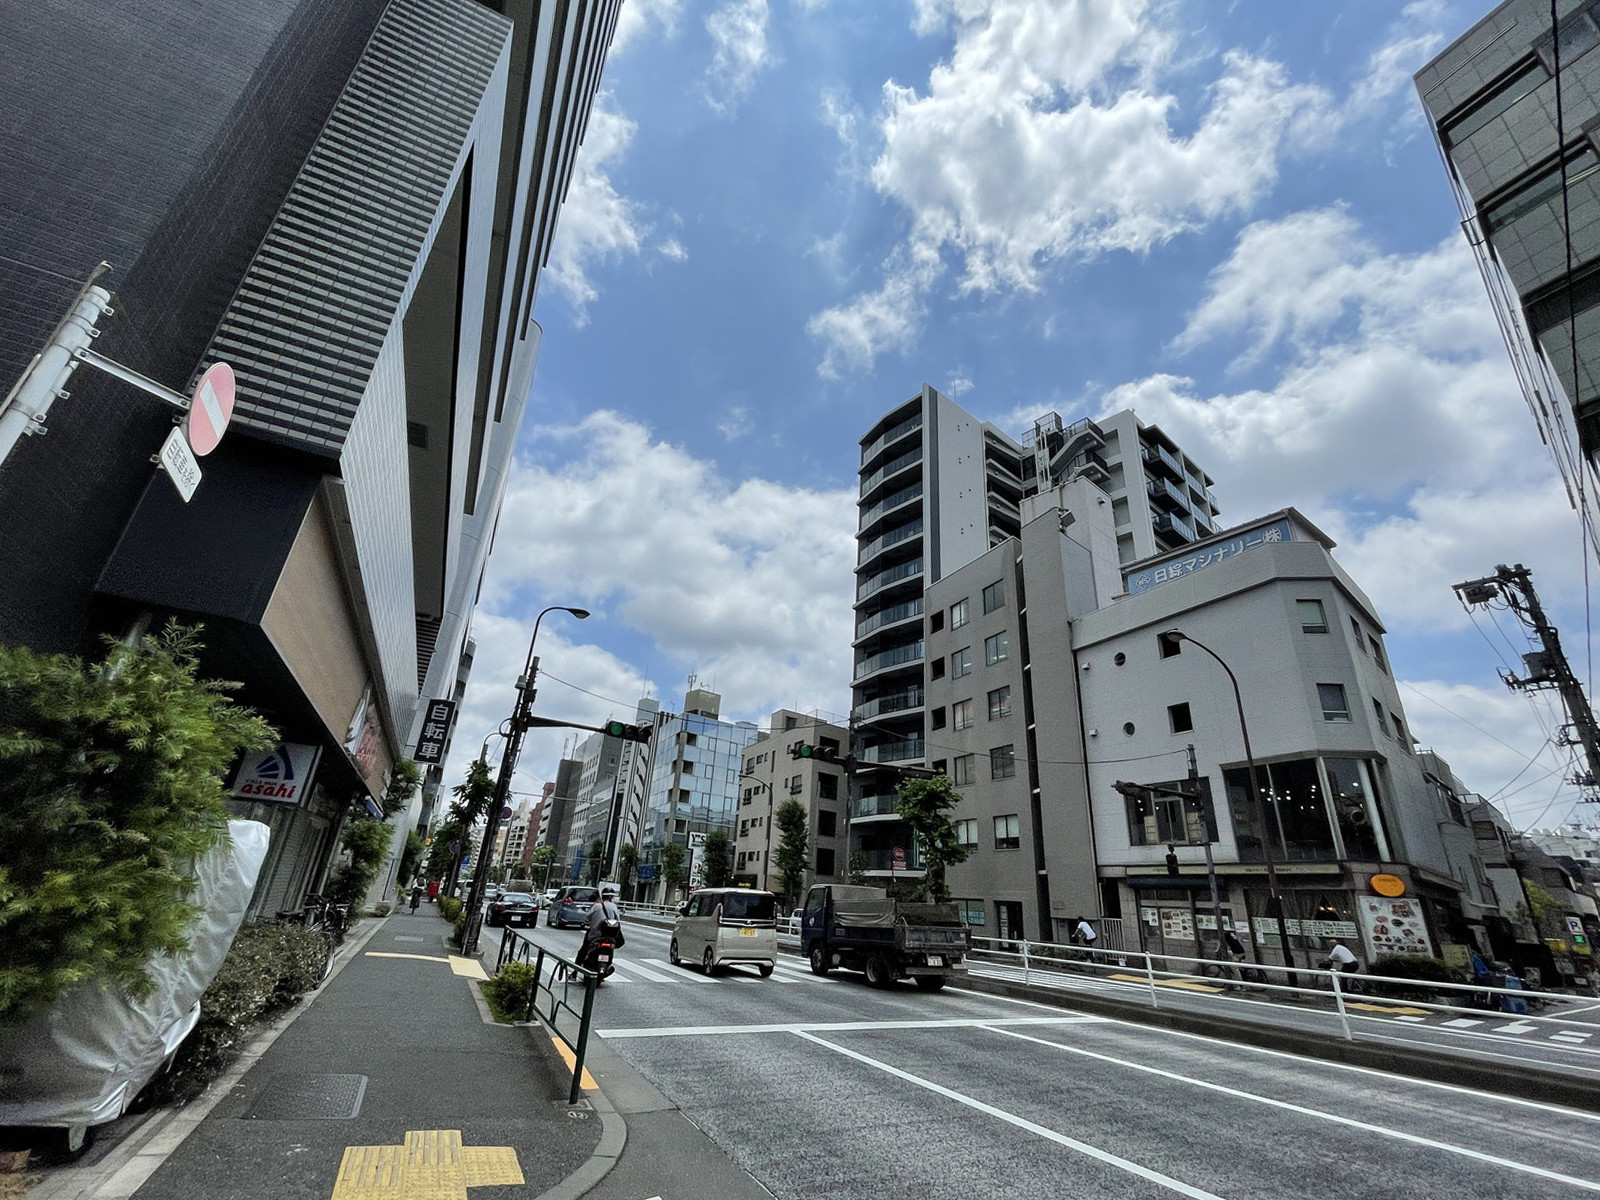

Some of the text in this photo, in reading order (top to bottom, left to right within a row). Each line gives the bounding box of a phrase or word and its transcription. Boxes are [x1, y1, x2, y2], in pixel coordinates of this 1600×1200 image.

[419, 704, 449, 759] 自転車
[241, 783, 297, 799] asahi
